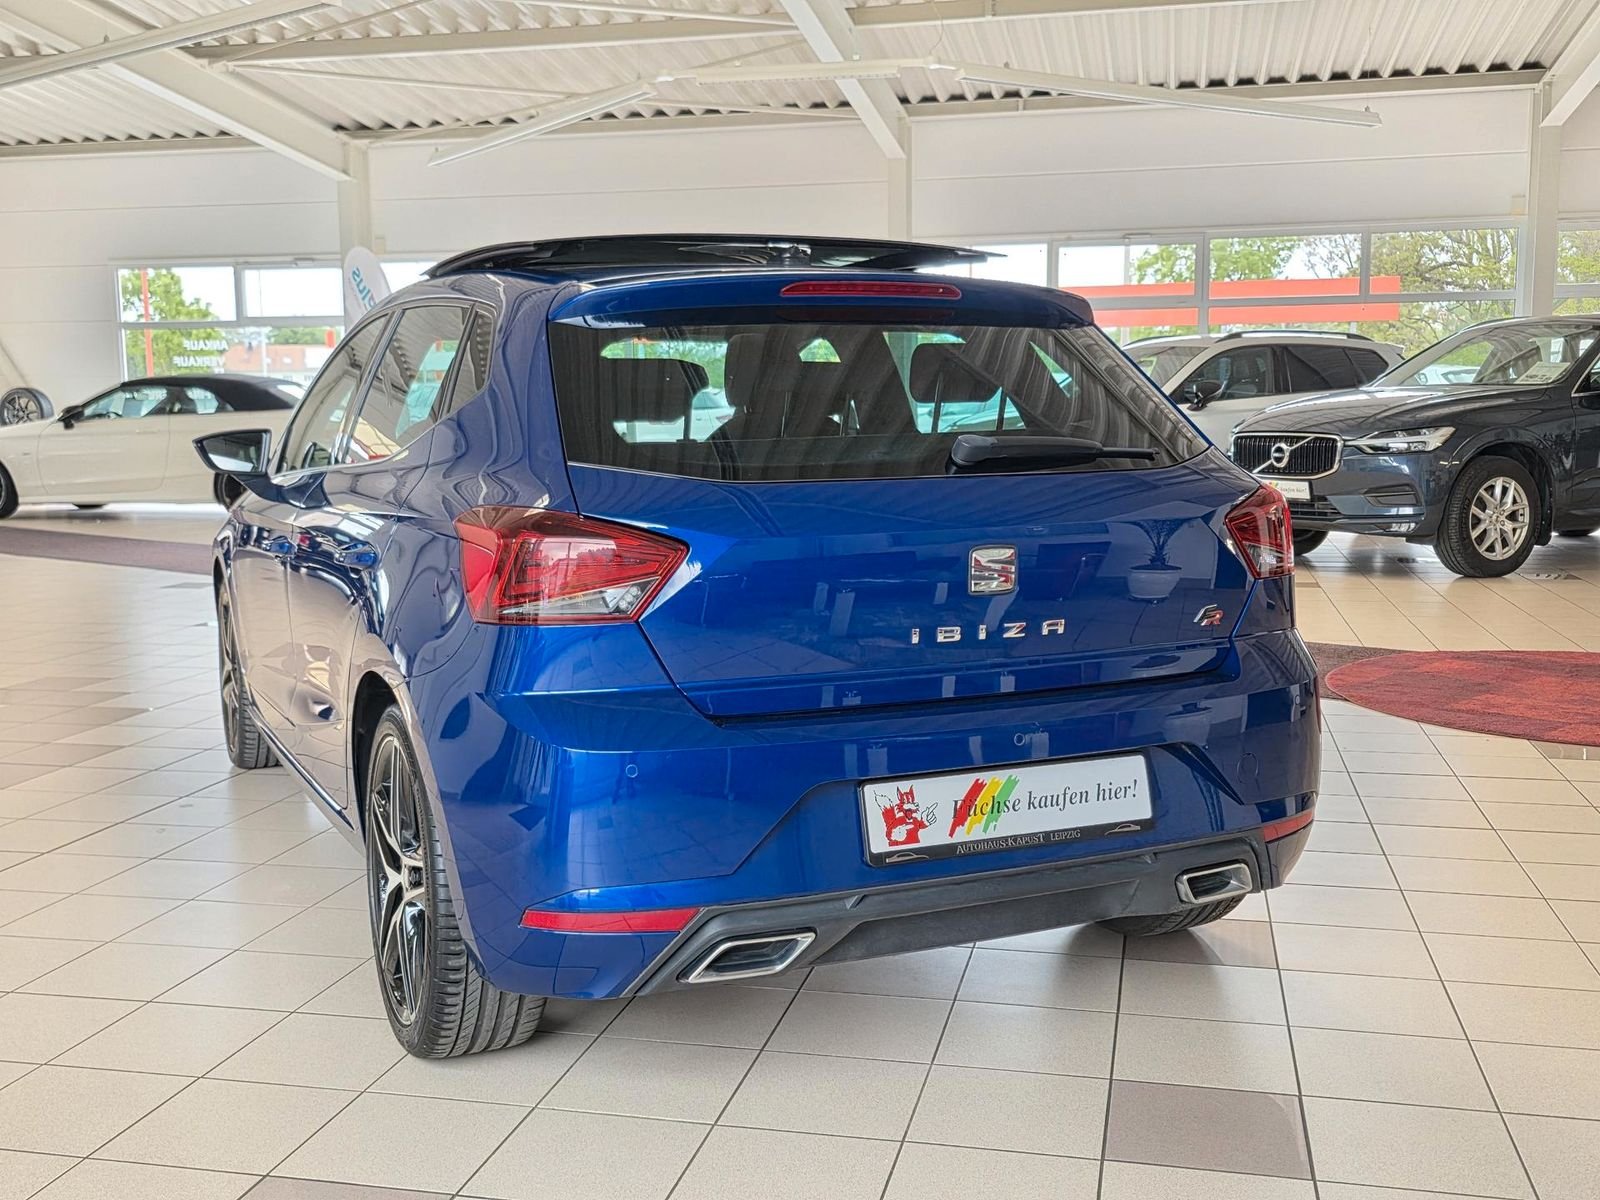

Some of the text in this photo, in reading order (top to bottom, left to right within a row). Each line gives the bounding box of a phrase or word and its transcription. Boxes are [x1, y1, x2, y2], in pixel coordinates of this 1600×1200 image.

[1193, 604, 1224, 626] FR
[911, 619, 1065, 644] IBIZA
[952, 779, 1138, 819] Füchse kaufen hier!
[1050, 829, 1081, 841] LEIPZIG
